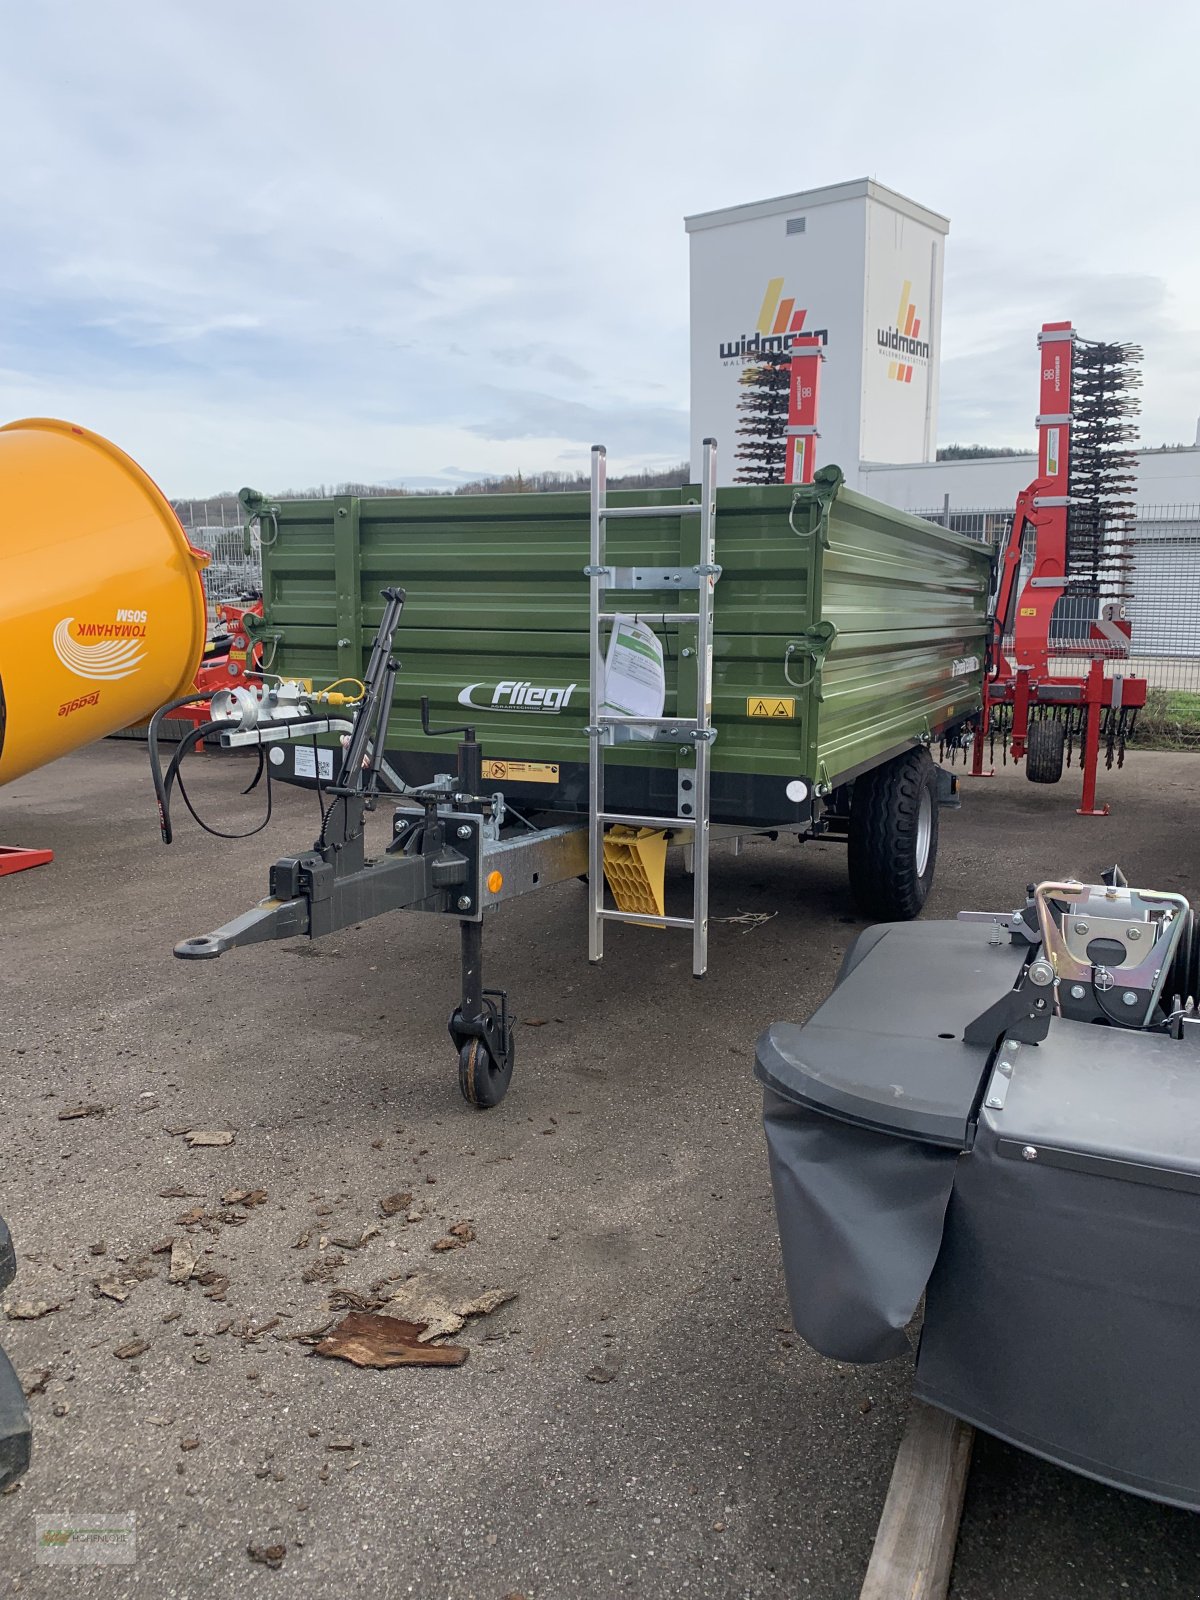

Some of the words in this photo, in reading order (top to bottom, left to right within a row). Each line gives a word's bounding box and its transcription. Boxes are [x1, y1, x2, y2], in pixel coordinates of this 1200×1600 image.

[877, 326, 929, 359] widmann
[116, 609, 148, 623] 505M
[77, 624, 146, 637] TOMAHAWK
[58, 690, 100, 717] Teagle
[491, 681, 578, 712] Fliegl
